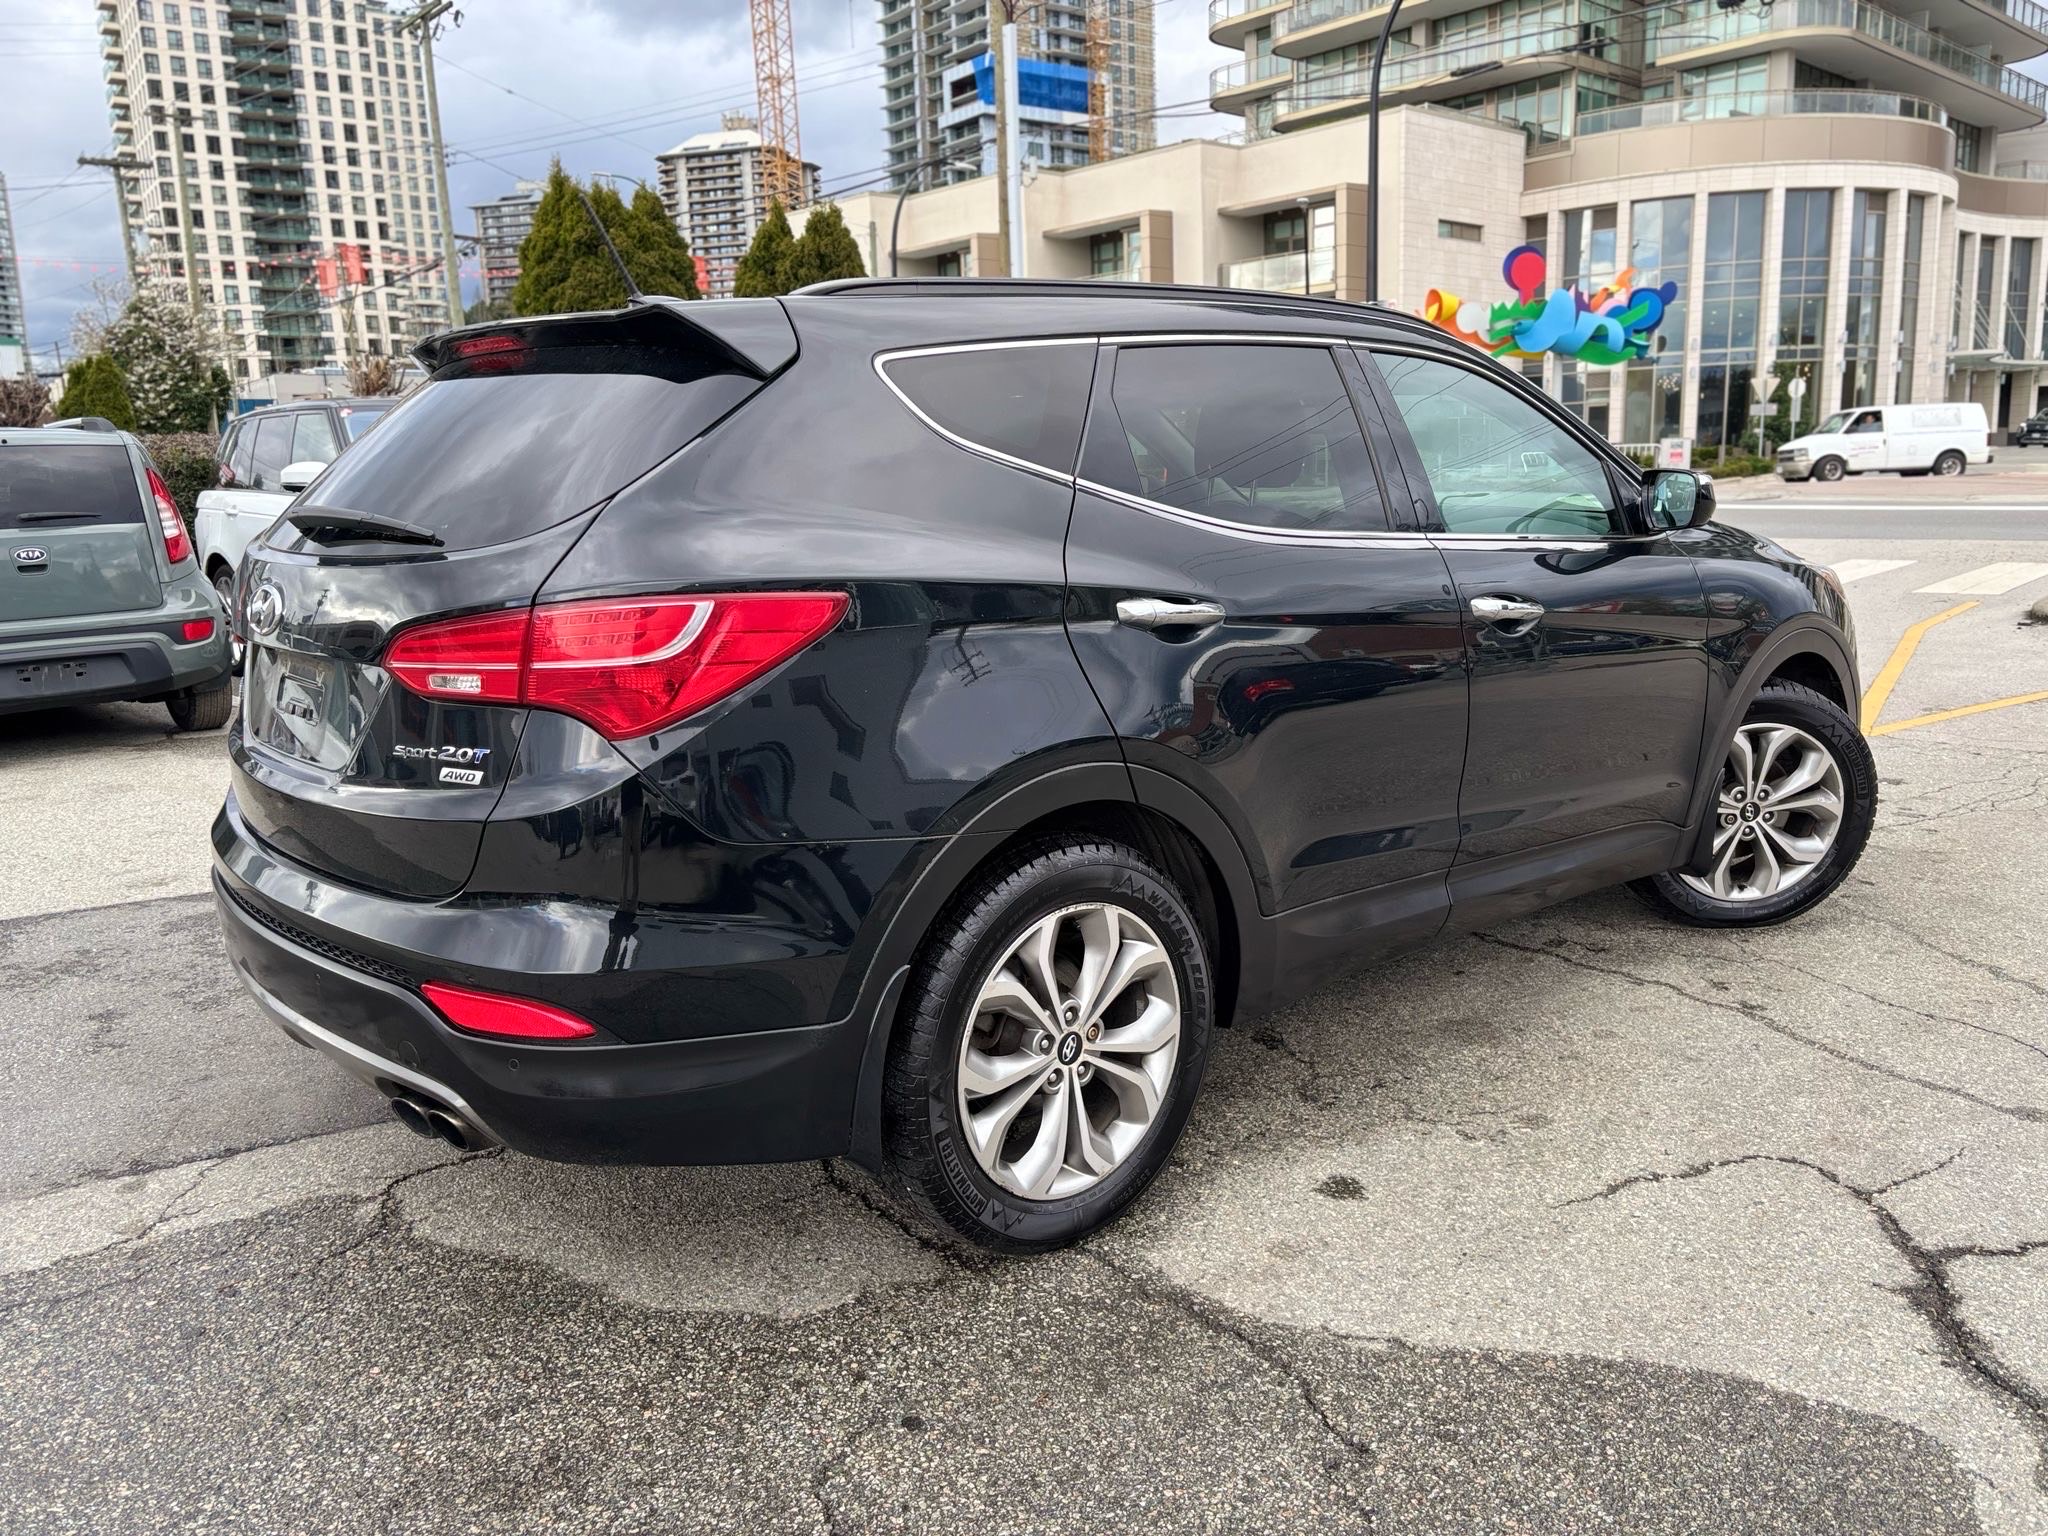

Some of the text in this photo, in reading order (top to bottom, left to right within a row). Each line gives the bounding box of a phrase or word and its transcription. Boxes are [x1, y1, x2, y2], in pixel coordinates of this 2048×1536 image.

[20, 550, 41, 559] KIA
[392, 745, 438, 759] Sport
[443, 770, 476, 782] AWD
[1149, 890, 1195, 957] WINTER
[941, 1140, 986, 1211] MOTOMASTER
